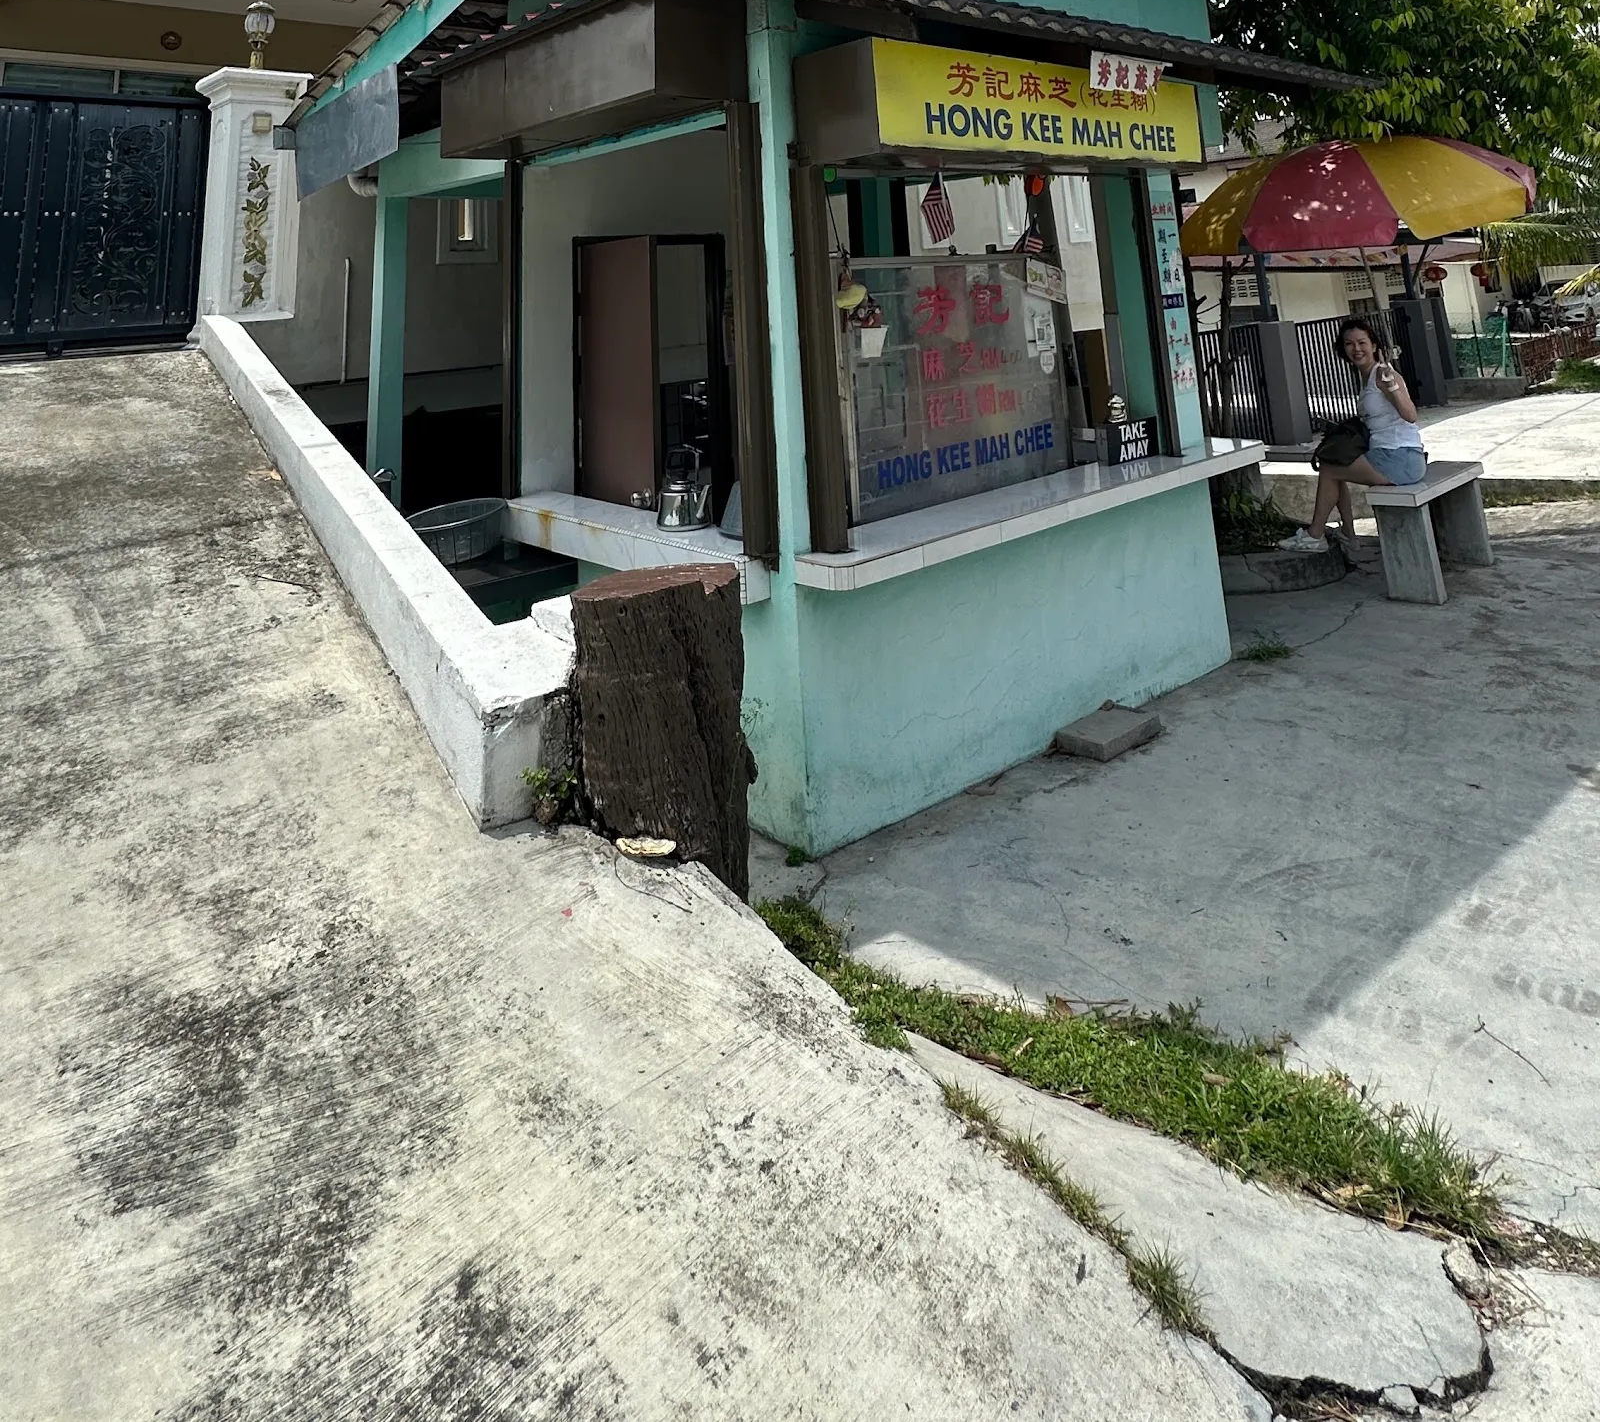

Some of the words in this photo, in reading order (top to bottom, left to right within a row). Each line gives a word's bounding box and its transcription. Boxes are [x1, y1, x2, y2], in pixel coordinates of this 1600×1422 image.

[925, 102, 1013, 140] HONG
[1021, 112, 1063, 144] KEE
[1072, 117, 1123, 149] MAH
[1129, 123, 1176, 152] CHEE
[913, 284, 1010, 335] 芳記
[877, 450, 932, 489] HONG
[936, 442, 971, 474] KEE
[974, 433, 1010, 465] MAH
[1014, 423, 1053, 455] CHEE
[1119, 421, 1147, 442] TAKE
[1120, 439, 1149, 462] AWAY
